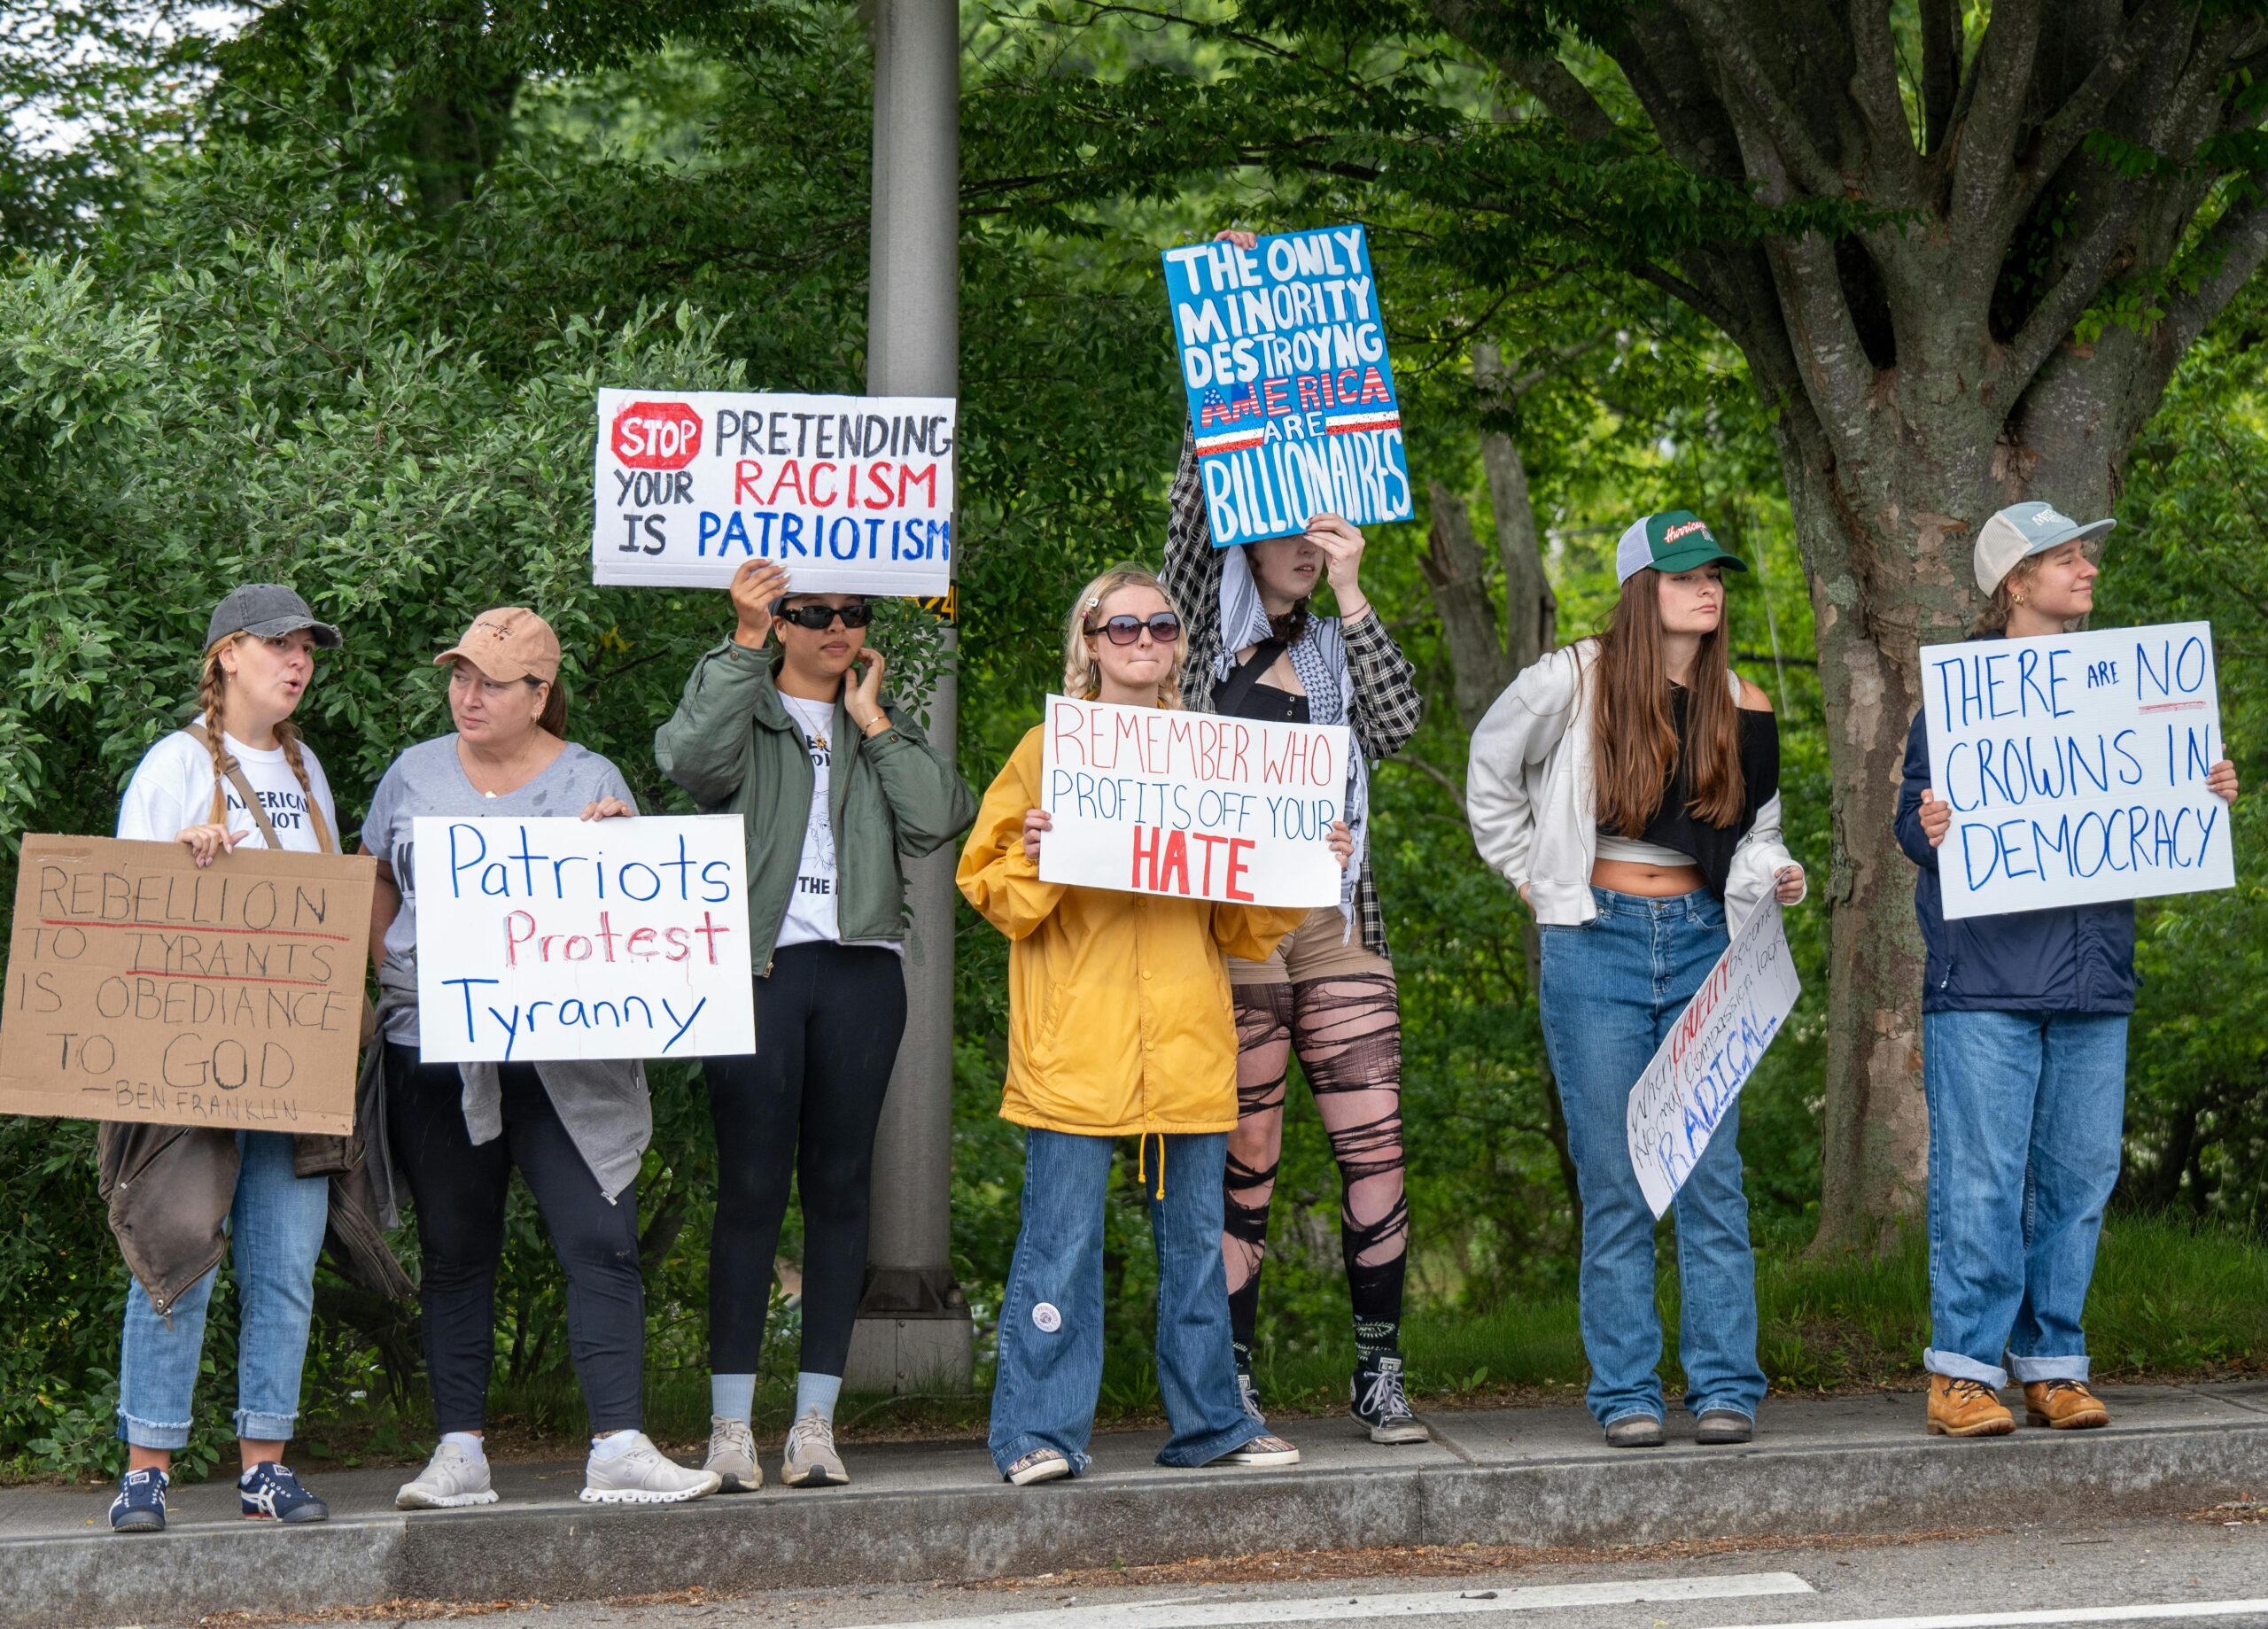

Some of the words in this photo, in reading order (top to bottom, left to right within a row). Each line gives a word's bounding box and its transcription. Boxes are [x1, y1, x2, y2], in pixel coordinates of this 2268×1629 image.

[1166, 243, 1263, 295] THE
[1267, 228, 1362, 282] ONLY
[1178, 275, 1372, 346] MINORITY
[1184, 322, 1384, 389] DESTROYNG
[1200, 366, 1392, 428] AMERICA
[1262, 410, 1325, 445] ARE
[619, 415, 697, 459] STOP
[715, 408, 953, 460] PRETENDING
[613, 467, 695, 508] YOUR
[734, 459, 937, 509] RACISM
[1204, 429, 1411, 543] BILLIONAIRES
[618, 513, 667, 555] IS
[697, 510, 951, 561] PATRIOTISM
[1932, 648, 2075, 733] THERE
[2087, 660, 2120, 689] ARE
[2136, 636, 2206, 701] NO
[1054, 702, 1250, 784] REMEMBER
[1263, 728, 1332, 787] WHO
[1946, 729, 2142, 812] CROWNS
[2167, 724, 2210, 787] IN
[1052, 769, 1192, 830] PROFITS
[1198, 789, 1257, 833] OFF
[1266, 795, 1335, 842] YOUR
[449, 823, 730, 903] Patriots
[1131, 825, 1255, 903] HATE
[1961, 805, 2218, 892] DEMOCRACY
[39, 865, 327, 930] REBELLION
[798, 876, 830, 895] THE
[22, 927, 87, 959] TO
[125, 932, 335, 983] TYRANTS
[505, 910, 730, 969] Protest
[20, 972, 63, 1013] IS
[96, 976, 346, 1031] OBEDIANCE
[441, 978, 707, 1062] Tyranny
[1673, 948, 1733, 1064] CRUELTY
[46, 1033, 115, 1074] TO
[162, 1032, 295, 1090] GOD
